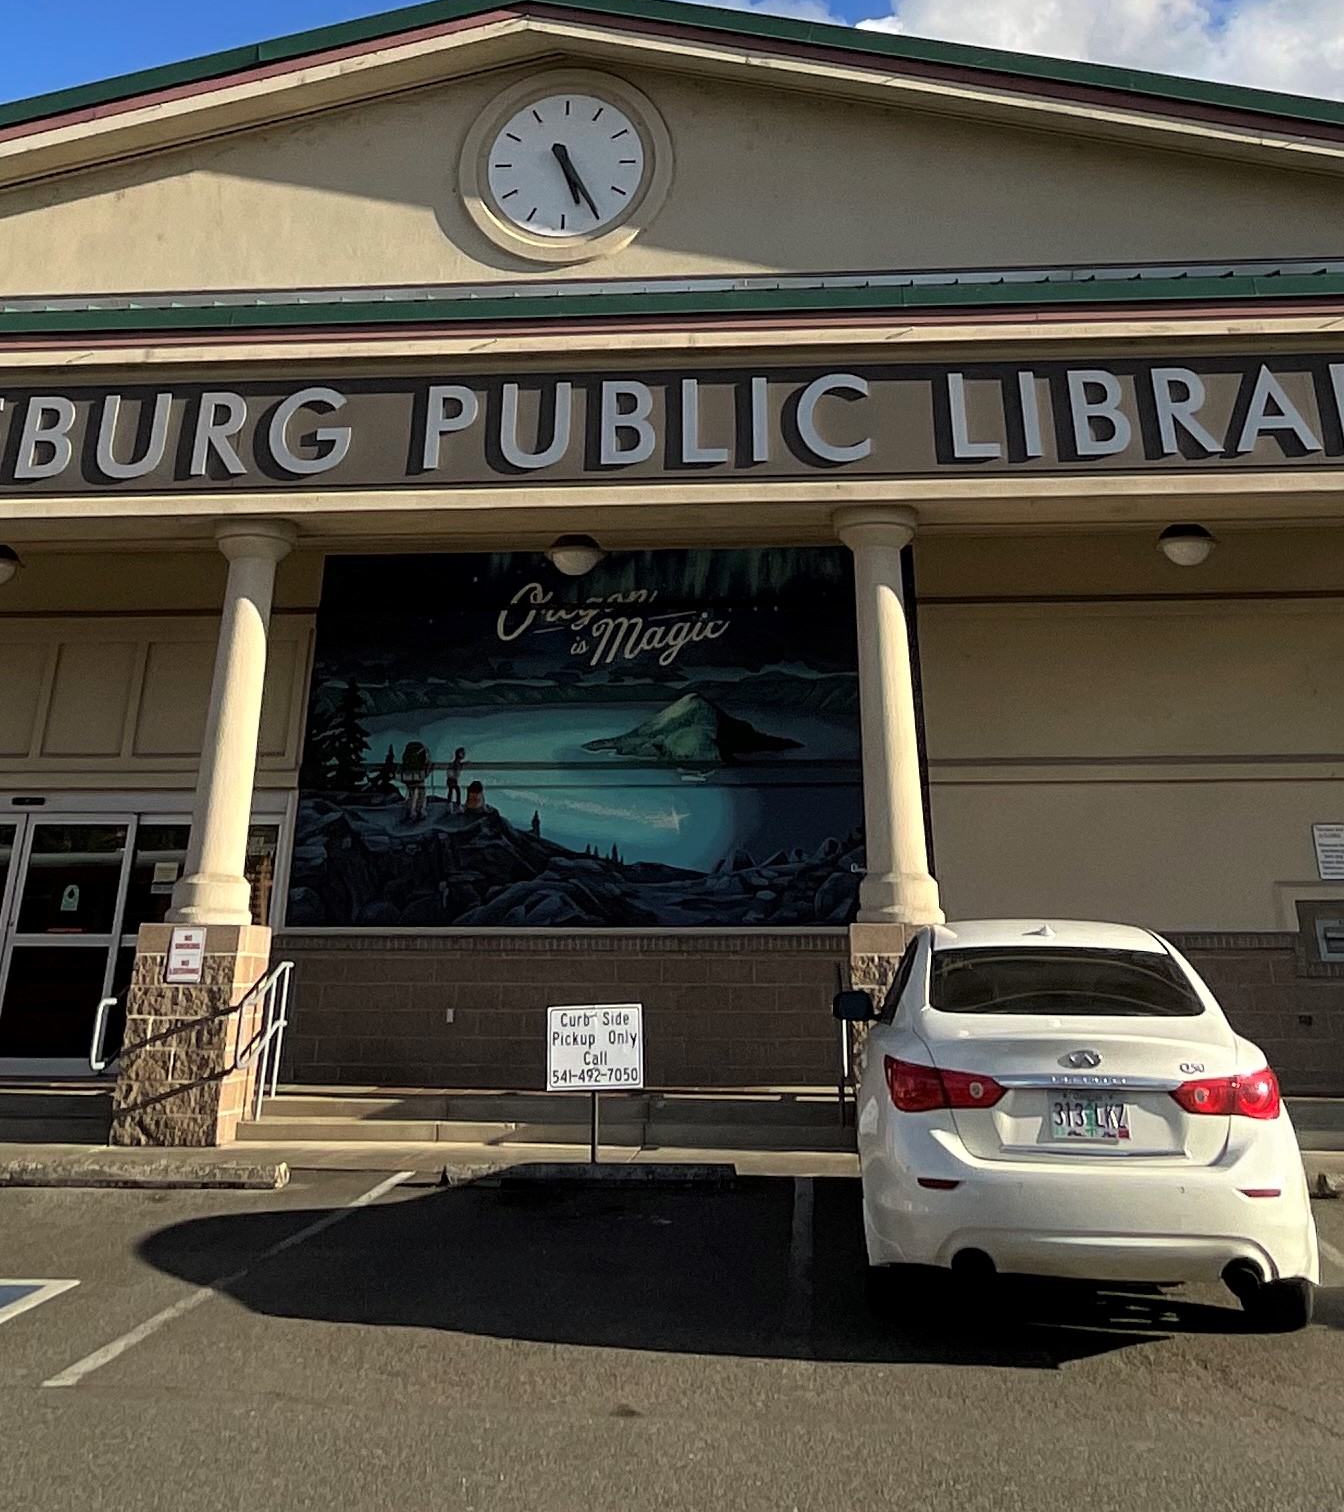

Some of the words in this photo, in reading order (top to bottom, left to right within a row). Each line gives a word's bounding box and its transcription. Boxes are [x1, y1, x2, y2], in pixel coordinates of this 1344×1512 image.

[422, 373, 872, 470] PUBLIC
[570, 636, 589, 655] is
[590, 611, 732, 666] Magic
[560, 1012, 590, 1027] Curb
[602, 1011, 630, 1026] Side
[552, 1031, 596, 1049] Pickup
[608, 1029, 637, 1049] Only
[583, 1050, 608, 1066] Call
[552, 1067, 638, 1084] 541-492-7050
[1054, 1101, 1086, 1128] 313
